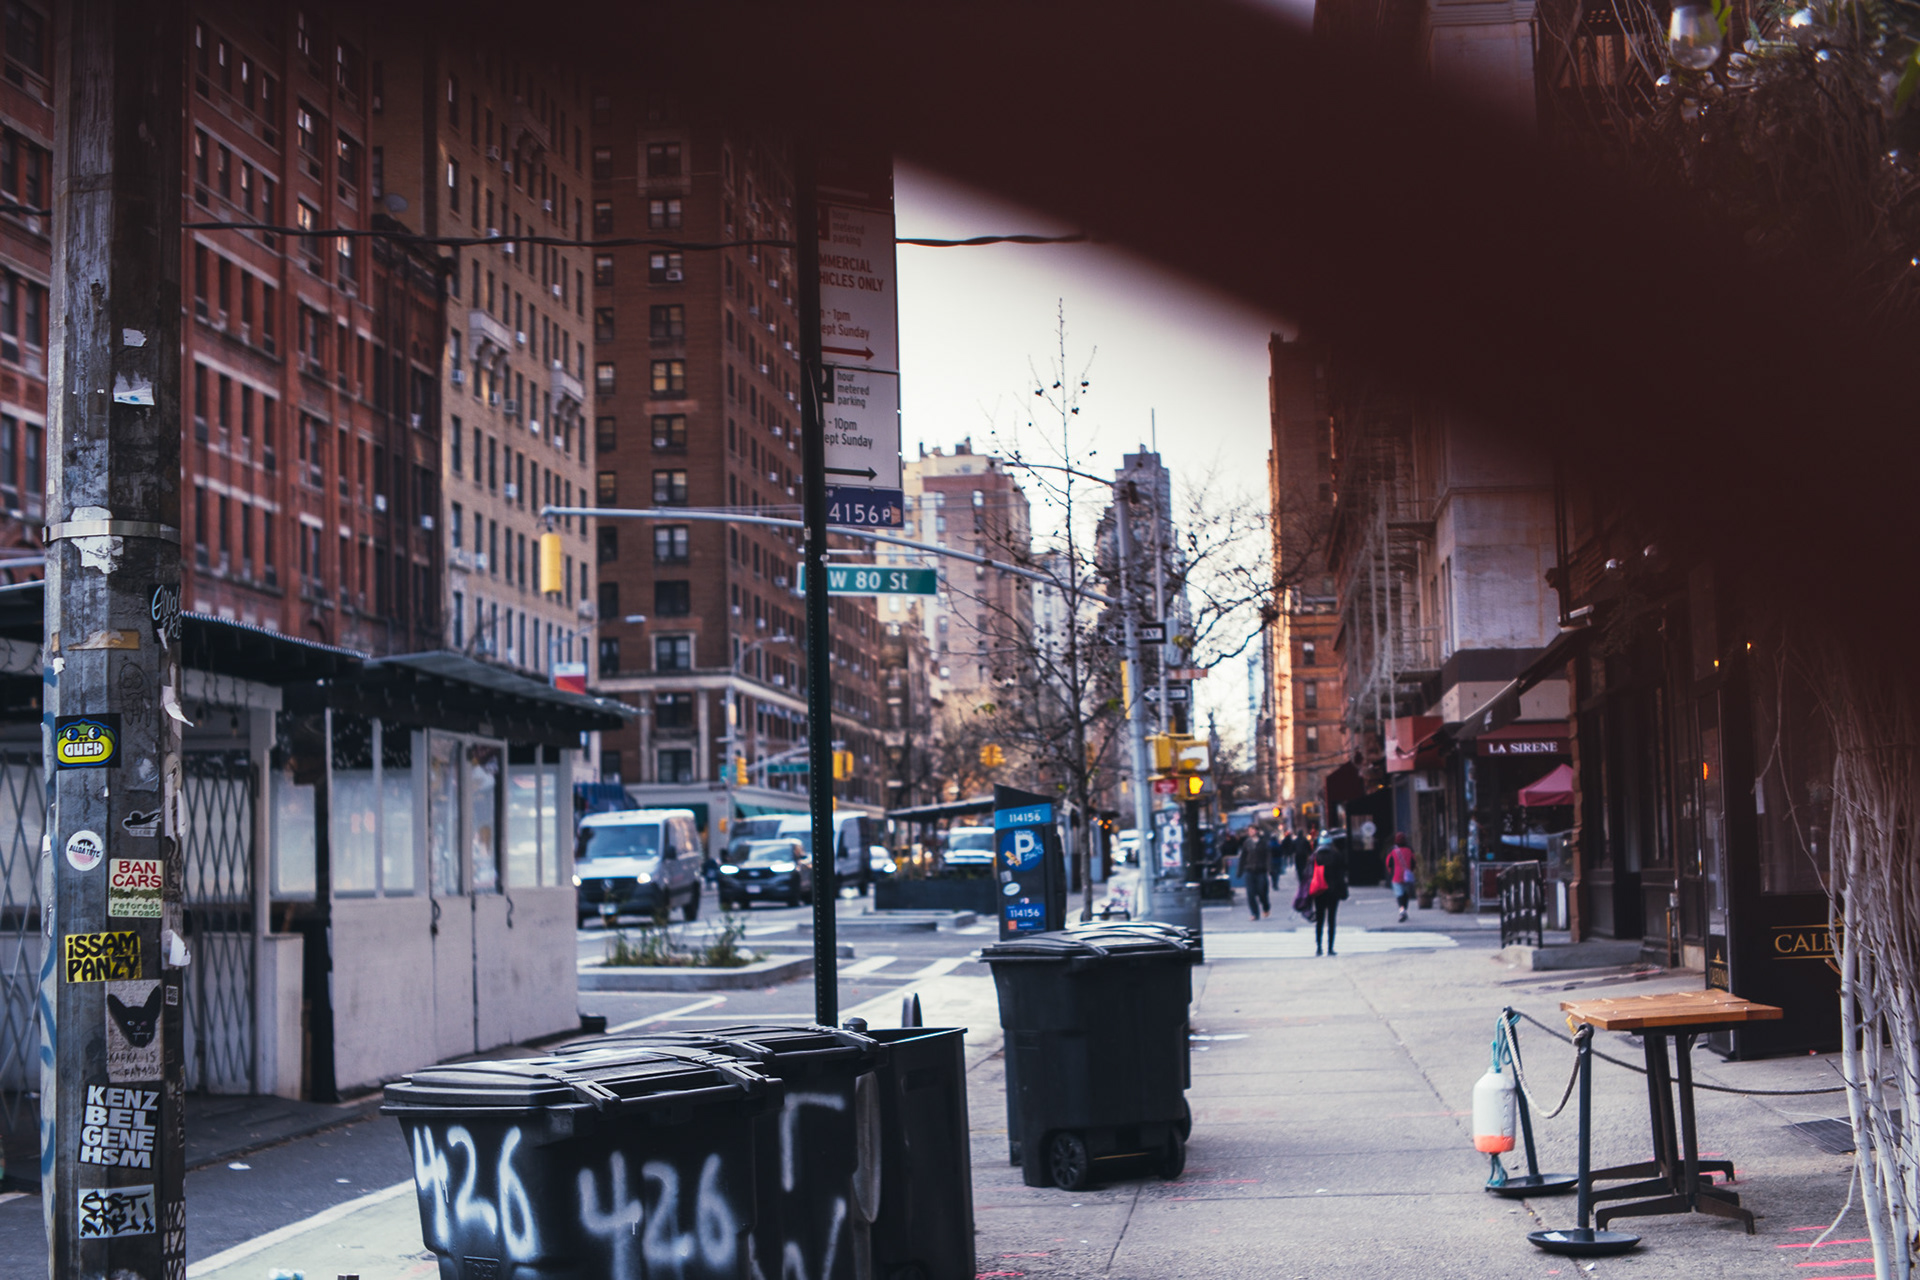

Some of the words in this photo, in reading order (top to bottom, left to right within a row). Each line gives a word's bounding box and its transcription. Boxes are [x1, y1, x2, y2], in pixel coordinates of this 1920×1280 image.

[819, 253, 872, 273] MMERCIAL
[819, 271, 855, 289] HICLES
[858, 276, 884, 292] ONLY
[833, 308, 851, 322] 1pm
[838, 324, 870, 340] Sunday
[837, 371, 855, 381] hour
[837, 384, 870, 396] metered
[837, 396, 866, 409] parking
[834, 417, 857, 432] 10pm
[841, 433, 873, 449] Sunday
[829, 570, 847, 588] W
[855, 571, 881, 589] 80
[889, 572, 908, 590] St
[64, 742, 104, 757] OUCH
[1489, 743, 1506, 754] LA
[1510, 741, 1558, 753] SIRENE
[1009, 812, 1041, 823] 114156
[119, 861, 156, 874] BAN
[112, 874, 162, 888] CARS
[113, 902, 160, 910] reforest
[132, 909, 161, 917] roads
[1010, 908, 1040, 918] 114156
[86, 1085, 160, 1111] KENZ
[84, 1105, 156, 1130] BEL
[81, 1125, 155, 1151] GENE
[80, 1146, 151, 1168] HSM
[412, 1125, 540, 1263] 426
[577, 1150, 738, 1280] 426
